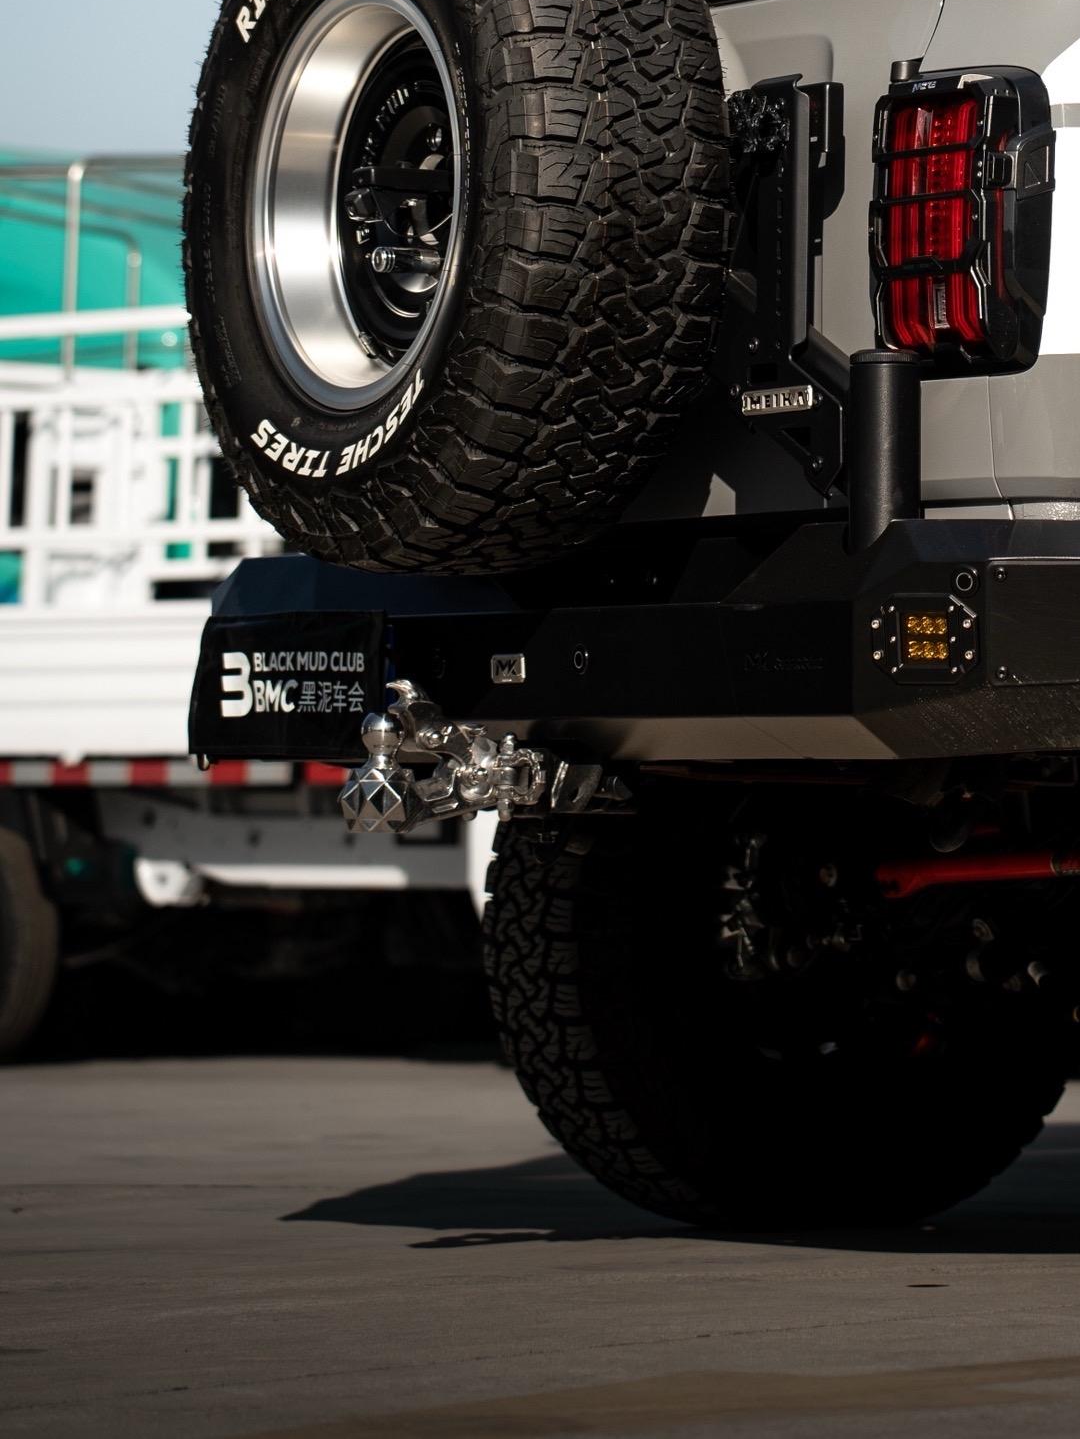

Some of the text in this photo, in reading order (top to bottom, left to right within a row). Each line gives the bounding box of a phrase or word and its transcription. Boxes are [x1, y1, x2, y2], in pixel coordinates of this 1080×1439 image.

[746, 391, 806, 411] MEIKA
[250, 368, 425, 478] TESCHE TIRES
[253, 651, 366, 672] BLACK MUD CLUB
[253, 679, 366, 713] BMC 黑泥车会
